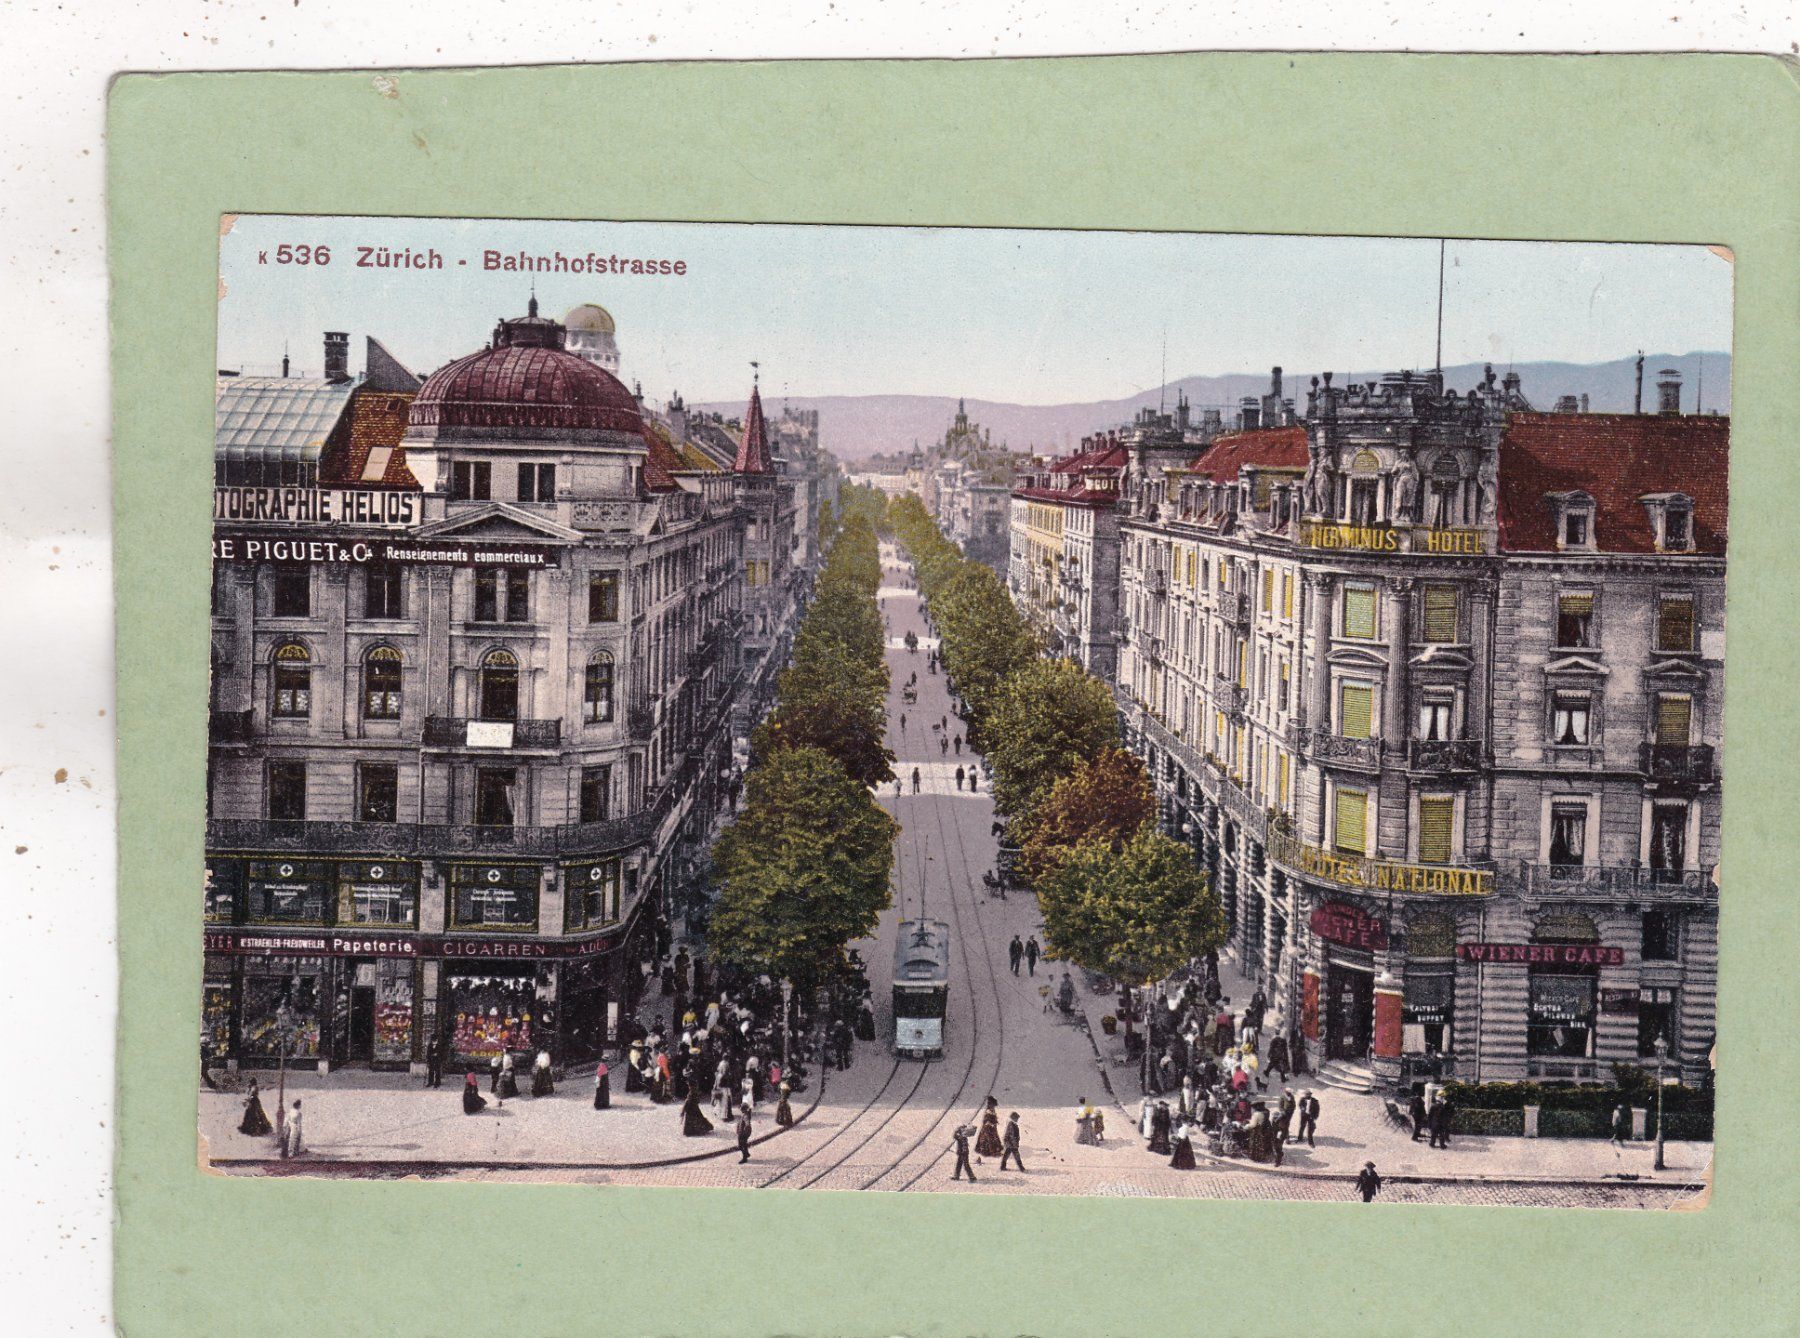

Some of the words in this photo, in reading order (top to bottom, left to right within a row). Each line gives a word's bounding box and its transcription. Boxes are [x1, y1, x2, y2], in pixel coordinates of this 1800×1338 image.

[213, 487, 331, 523] TOGRAPHIE
[246, 540, 339, 562] PIGUET
[386, 546, 469, 562] Renseignements
[474, 552, 545, 564] commerciaux
[1427, 531, 1482, 552] HOTEL
[443, 942, 545, 956] CIGARREN
[1468, 945, 1557, 962] WIENER
[1565, 948, 1622, 964] CAFE
